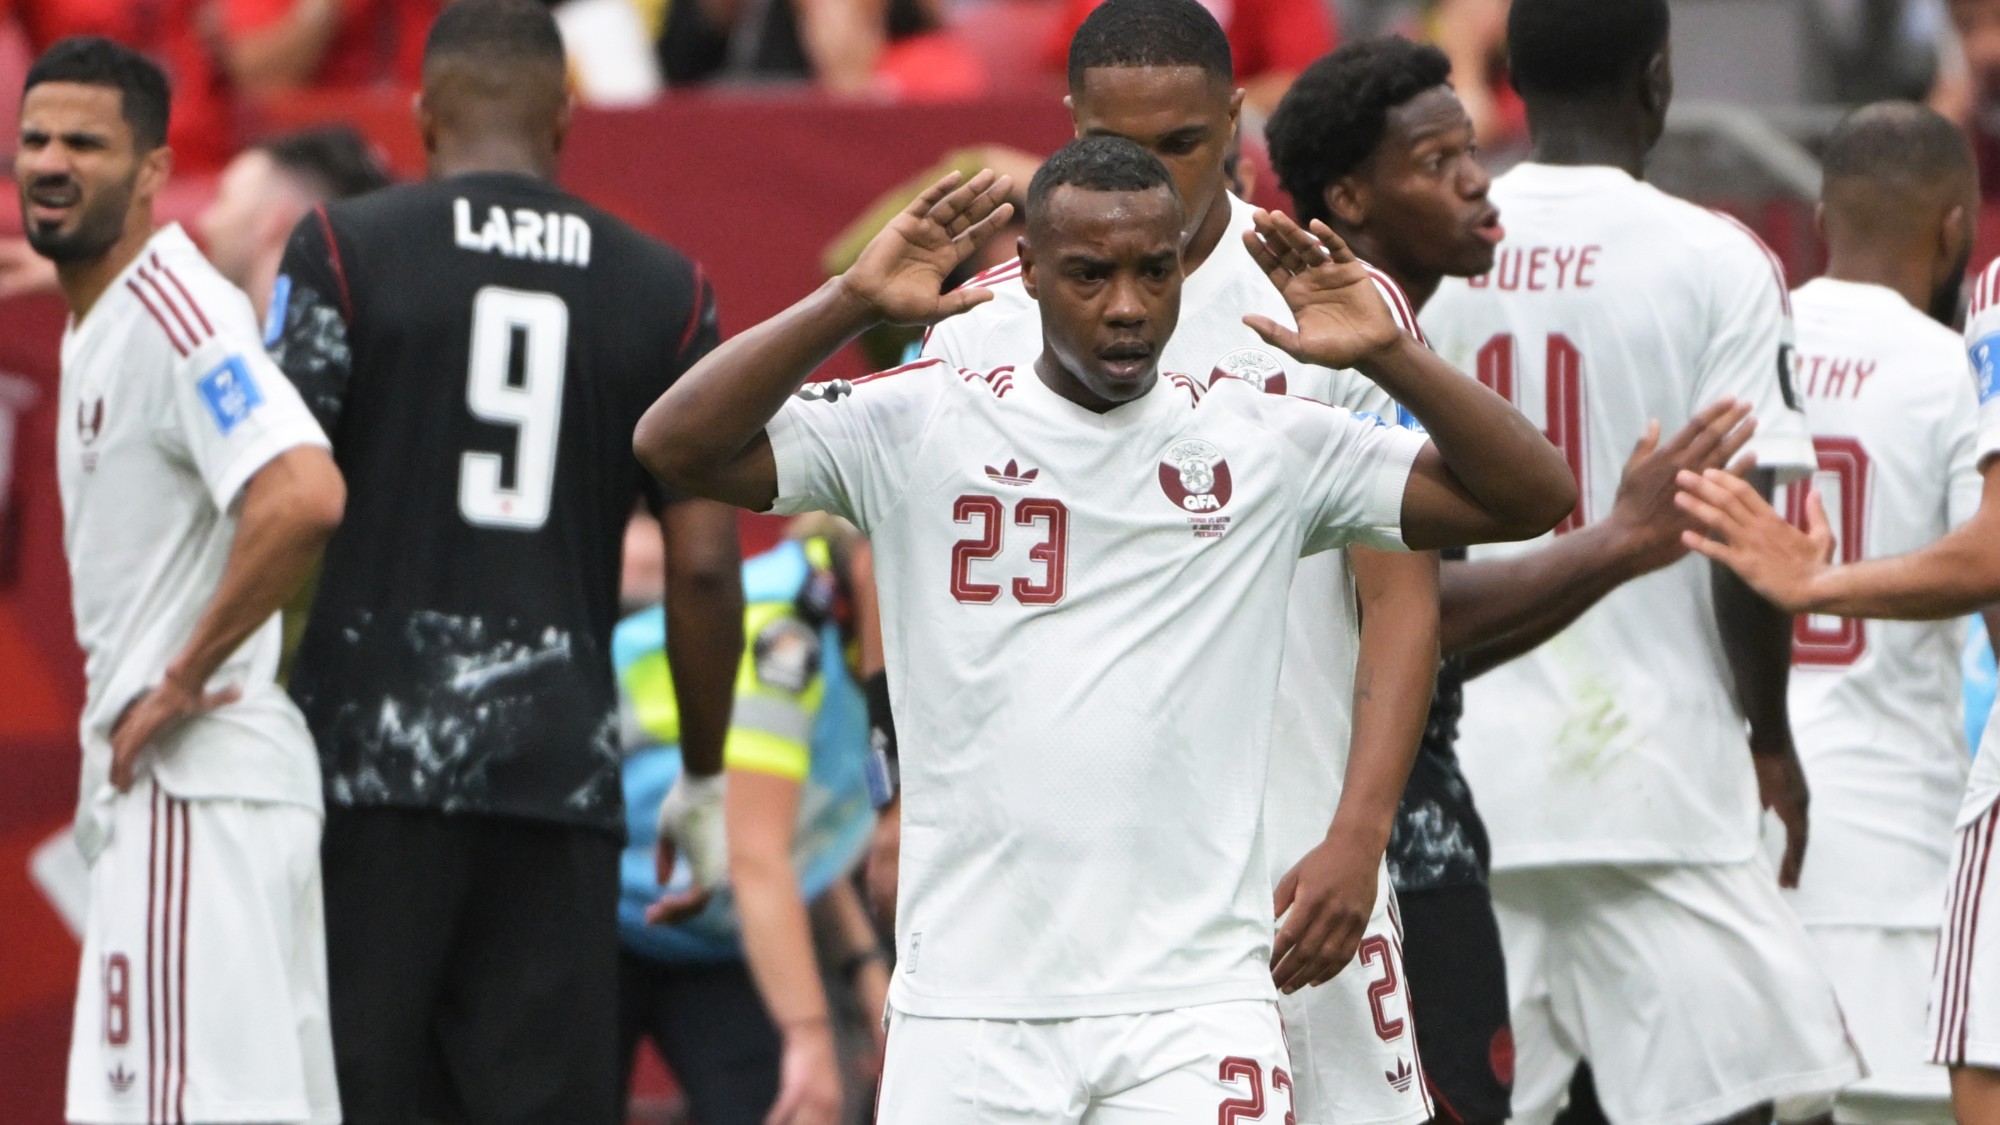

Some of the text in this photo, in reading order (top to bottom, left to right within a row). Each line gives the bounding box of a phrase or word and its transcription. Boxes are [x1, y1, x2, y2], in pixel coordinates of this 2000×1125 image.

[454, 197, 591, 268] LARIN
[1468, 245, 1603, 291] UEYE
[457, 285, 569, 531] 9
[1795, 354, 1876, 399] THY
[1183, 494, 1221, 510] QFA
[950, 495, 1070, 606] 23
[1358, 933, 1404, 1043] 2
